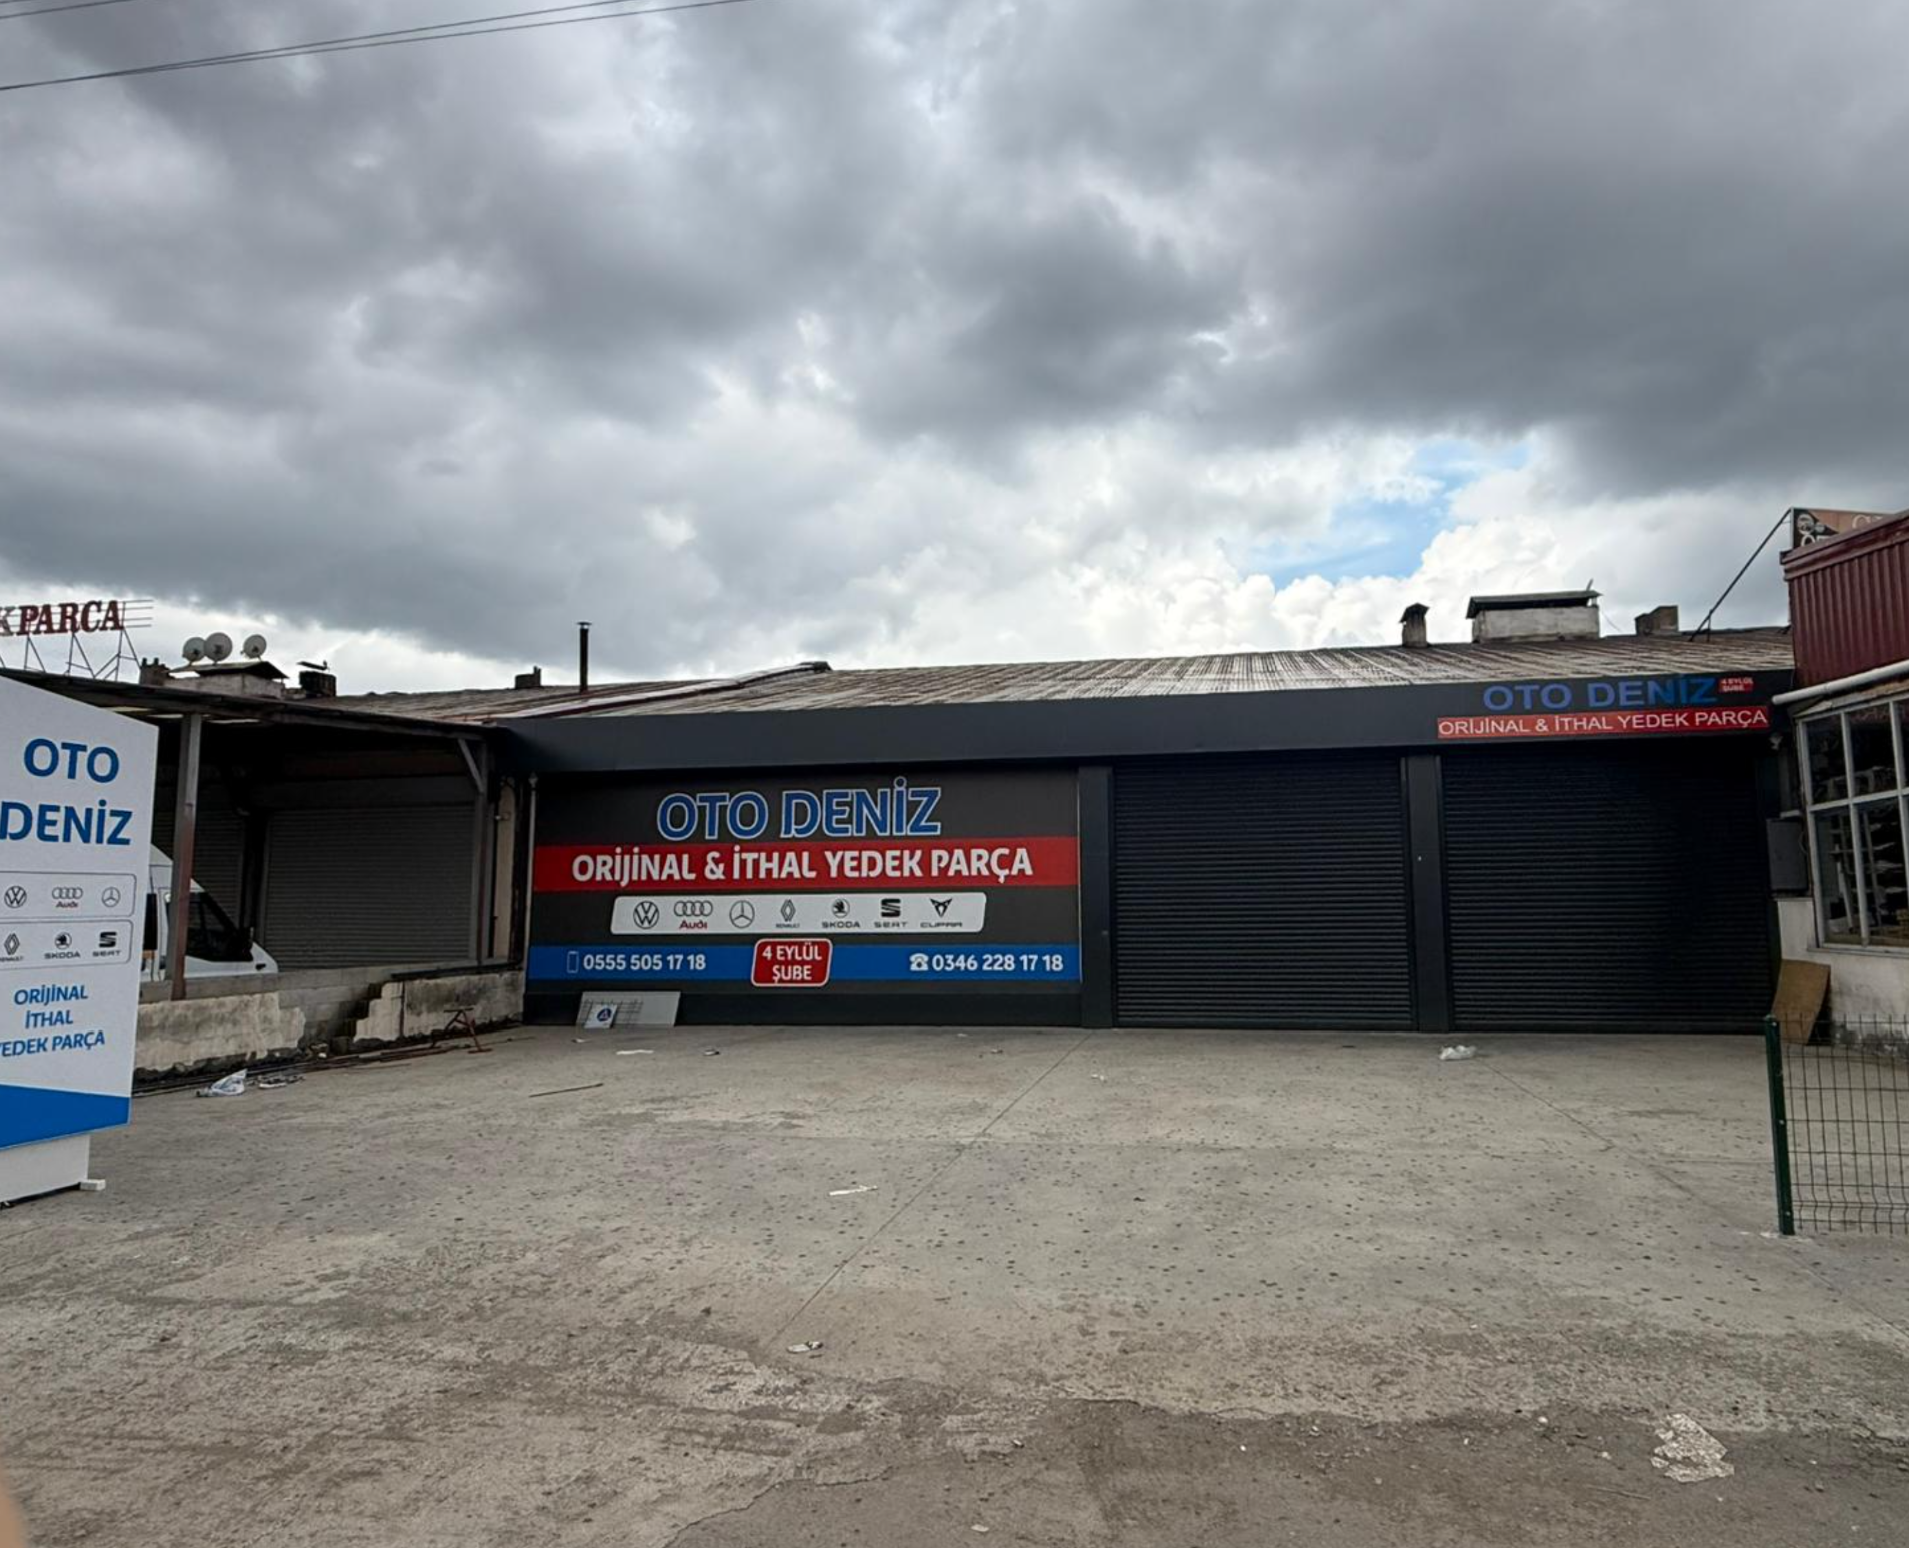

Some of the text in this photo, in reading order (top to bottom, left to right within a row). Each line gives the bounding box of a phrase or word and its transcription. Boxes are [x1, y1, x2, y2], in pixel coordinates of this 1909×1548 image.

[1483, 683, 1572, 711] OTO
[1535, 718, 1549, 733] &
[1617, 712, 1690, 729] YEDEK
[1694, 709, 1768, 729] PARÇA
[24, 738, 120, 784] OTO
[656, 776, 942, 841] OTO DENİZ
[0, 799, 133, 845] DENİZ
[571, 844, 1034, 887] ORİJİNAL & İTHAL YEDEK PARÇA
[679, 919, 708, 930] Audi
[583, 953, 706, 971] 0555 505 17 18
[762, 942, 822, 961] 4 EYLÜL
[932, 953, 1064, 972] 0346 228 17 18
[772, 965, 812, 984] ŞUBE
[0, 1030, 105, 1057] EDEK PARÇA
